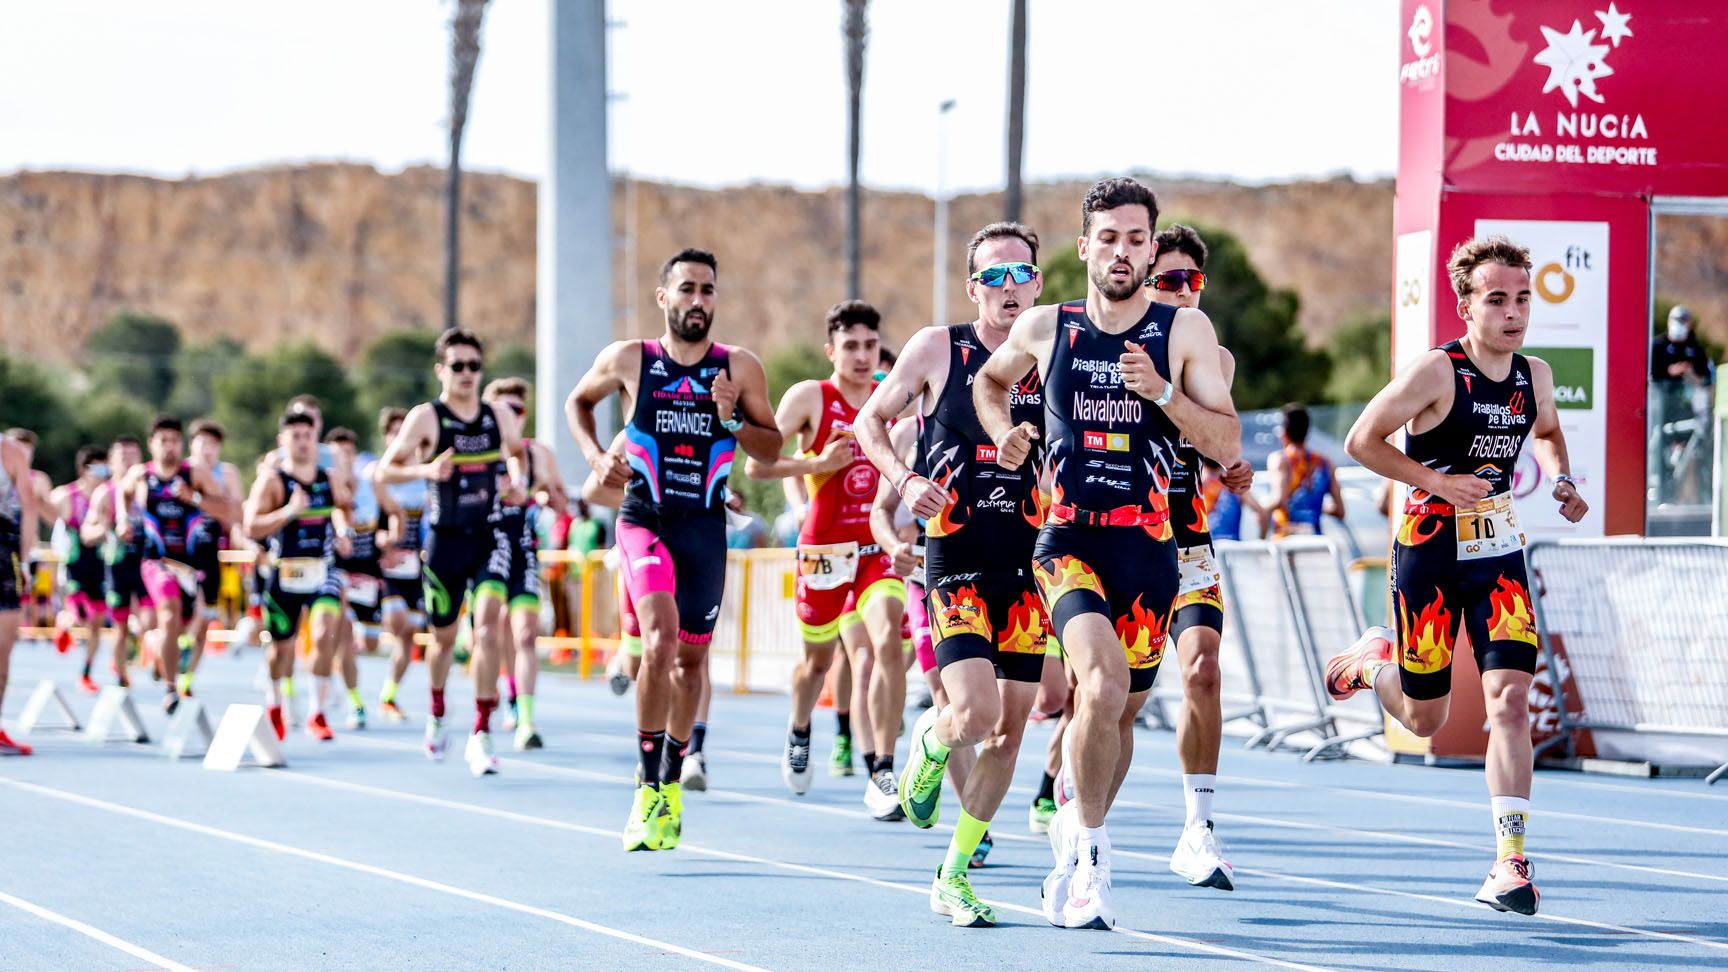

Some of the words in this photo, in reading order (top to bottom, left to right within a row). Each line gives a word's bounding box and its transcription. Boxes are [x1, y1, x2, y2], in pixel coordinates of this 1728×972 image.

[1510, 111, 1541, 136] LA
[1494, 143, 1554, 162] CIUDAD
[1555, 144, 1585, 163] DEL
[1586, 146, 1658, 165] DEPORTE
[1566, 245, 1591, 270] fit
[655, 407, 713, 437] FERNÁNDEZ
[1073, 391, 1142, 429] Navalpotro
[1087, 435, 1104, 446] TM
[1468, 435, 1521, 458] FIGUERAS
[980, 449, 996, 458] TM
